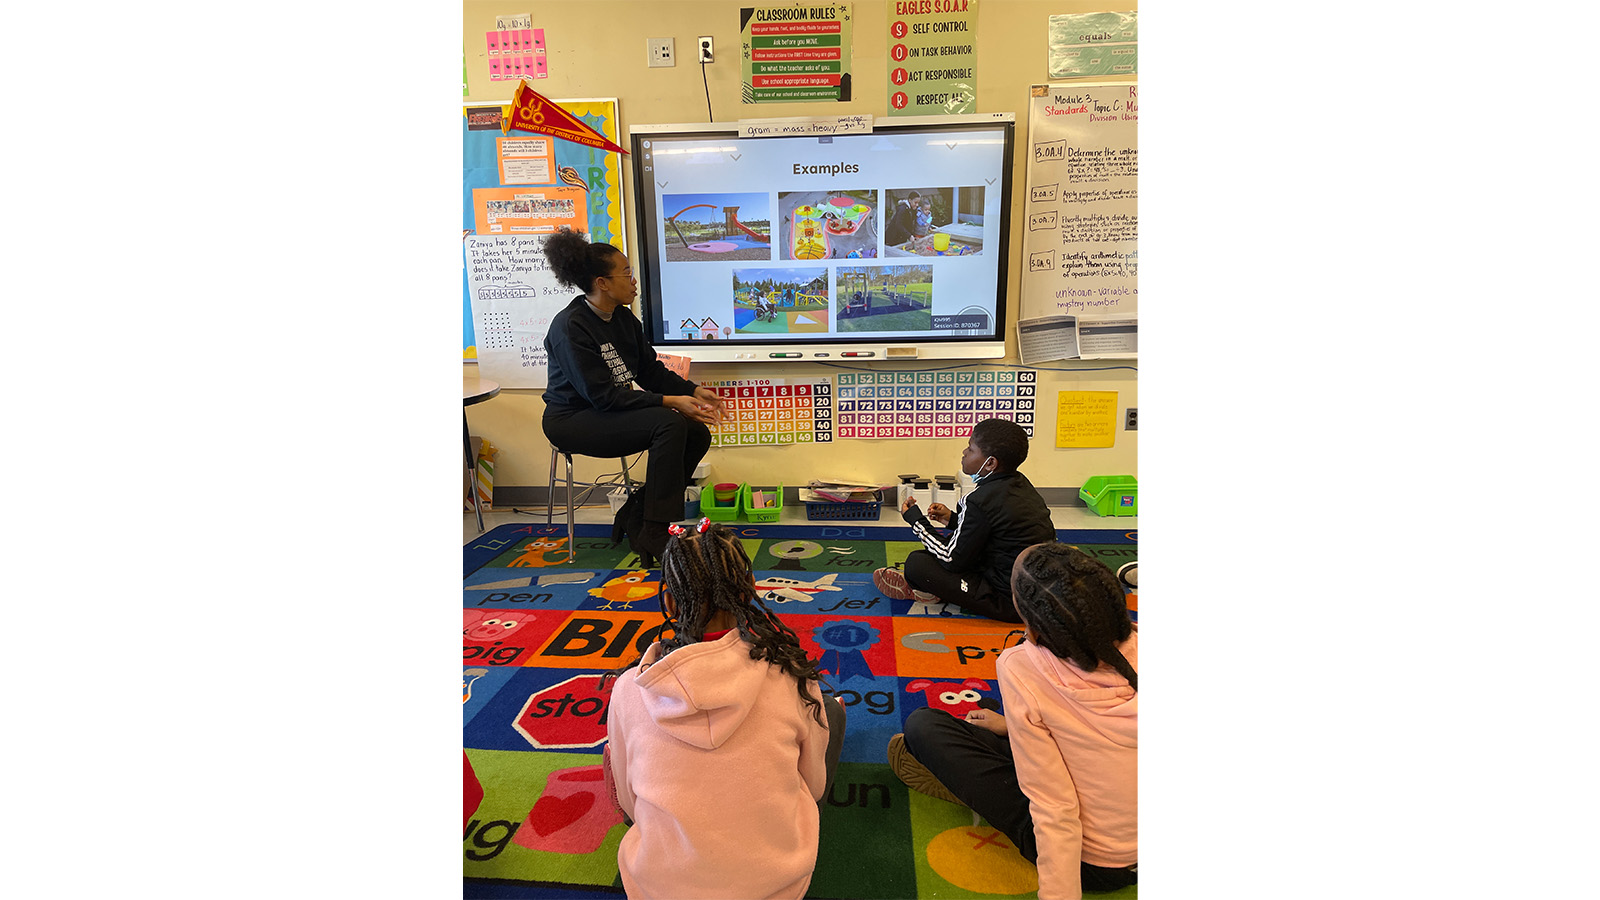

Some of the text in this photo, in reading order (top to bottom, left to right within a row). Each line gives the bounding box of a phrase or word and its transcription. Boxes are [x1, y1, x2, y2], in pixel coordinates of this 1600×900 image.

[896, 0, 931, 15] EAGLES
[757, 7, 836, 21] CLASSROOM RULES
[896, 21, 968, 36] S SELF CONTROL
[1079, 32, 1112, 43] equals
[896, 45, 972, 59] O ON TASK BEHAVIOR
[896, 68, 972, 82] A ACT RESPONSIBLE
[897, 94, 903, 107] R
[916, 94, 948, 105] RESPECT
[1055, 94, 1092, 104] Module 3
[1045, 104, 1088, 116] Standards
[1093, 100, 1111, 113] Topic
[1090, 113, 1117, 122] Division
[515, 121, 539, 131] UNIVERSITY
[555, 129, 574, 139] DISTRICT
[581, 137, 604, 147] COLUMBIA
[748, 126, 770, 137] gram
[813, 124, 837, 134] heavy
[1068, 147, 1115, 158] Determine the
[794, 162, 859, 176] Examples
[496, 237, 507, 246] has
[511, 237, 516, 246] 8
[518, 240, 534, 249] pans
[502, 248, 512, 256] her
[1062, 251, 1124, 263] Identify arithmetic
[473, 257, 487, 265] each
[489, 258, 502, 267] pan
[1062, 262, 1083, 271] explain
[1104, 262, 1122, 271] using
[1098, 286, 1130, 296] variable
[1057, 298, 1120, 314] mystery number
[701, 380, 742, 388] NUMBERS
[840, 373, 1034, 384] 51 52 53 54 55 56 57 58 59 60
[724, 389, 730, 397] 5
[762, 388, 768, 396] 7
[781, 387, 787, 395] 8
[817, 386, 829, 394] 10
[840, 402, 852, 410] 71
[899, 401, 912, 409] 74
[918, 401, 931, 409] 75
[938, 401, 951, 409] 76
[958, 401, 971, 409] 77
[978, 401, 992, 409] 78
[998, 401, 1012, 409] 79
[1018, 401, 1032, 409] 80
[724, 435, 736, 443] 45
[743, 435, 755, 443] 46
[779, 434, 791, 442] 48
[799, 433, 811, 441] 49
[821, 527, 865, 537] Dd
[825, 556, 874, 568] fan
[478, 591, 553, 605] pen
[818, 596, 880, 612] jet
[829, 627, 857, 642] #1
